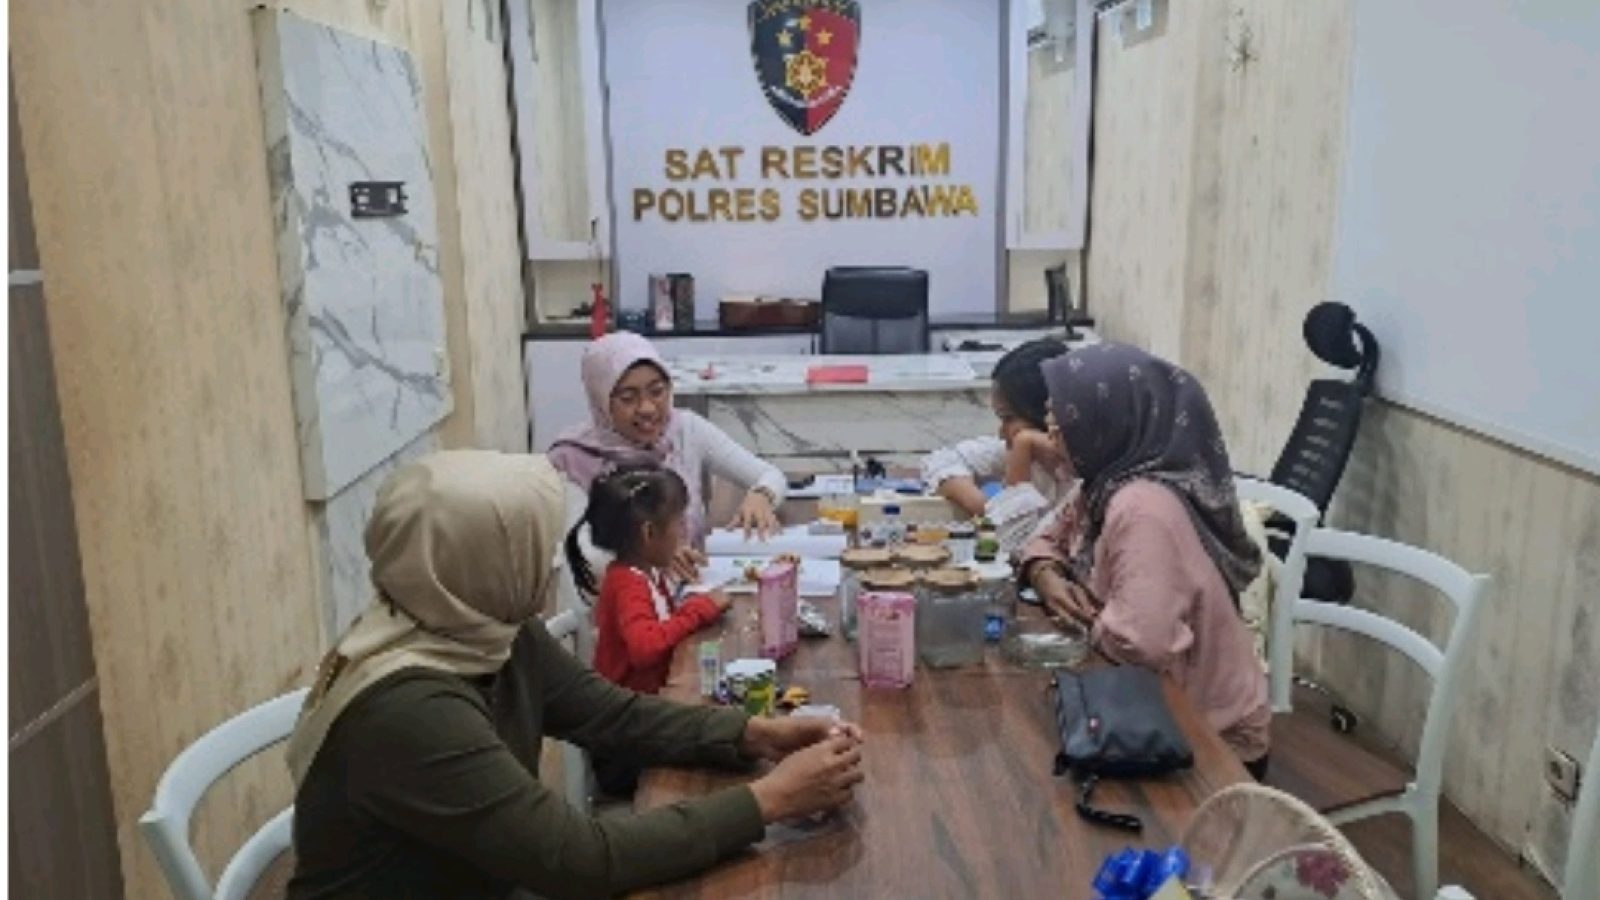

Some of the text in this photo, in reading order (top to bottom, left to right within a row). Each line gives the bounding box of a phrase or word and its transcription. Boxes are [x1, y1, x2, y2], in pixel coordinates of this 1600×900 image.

[664, 143, 951, 181] SAT RESKRIM
[633, 184, 979, 221] POLRES SUMBAWA
